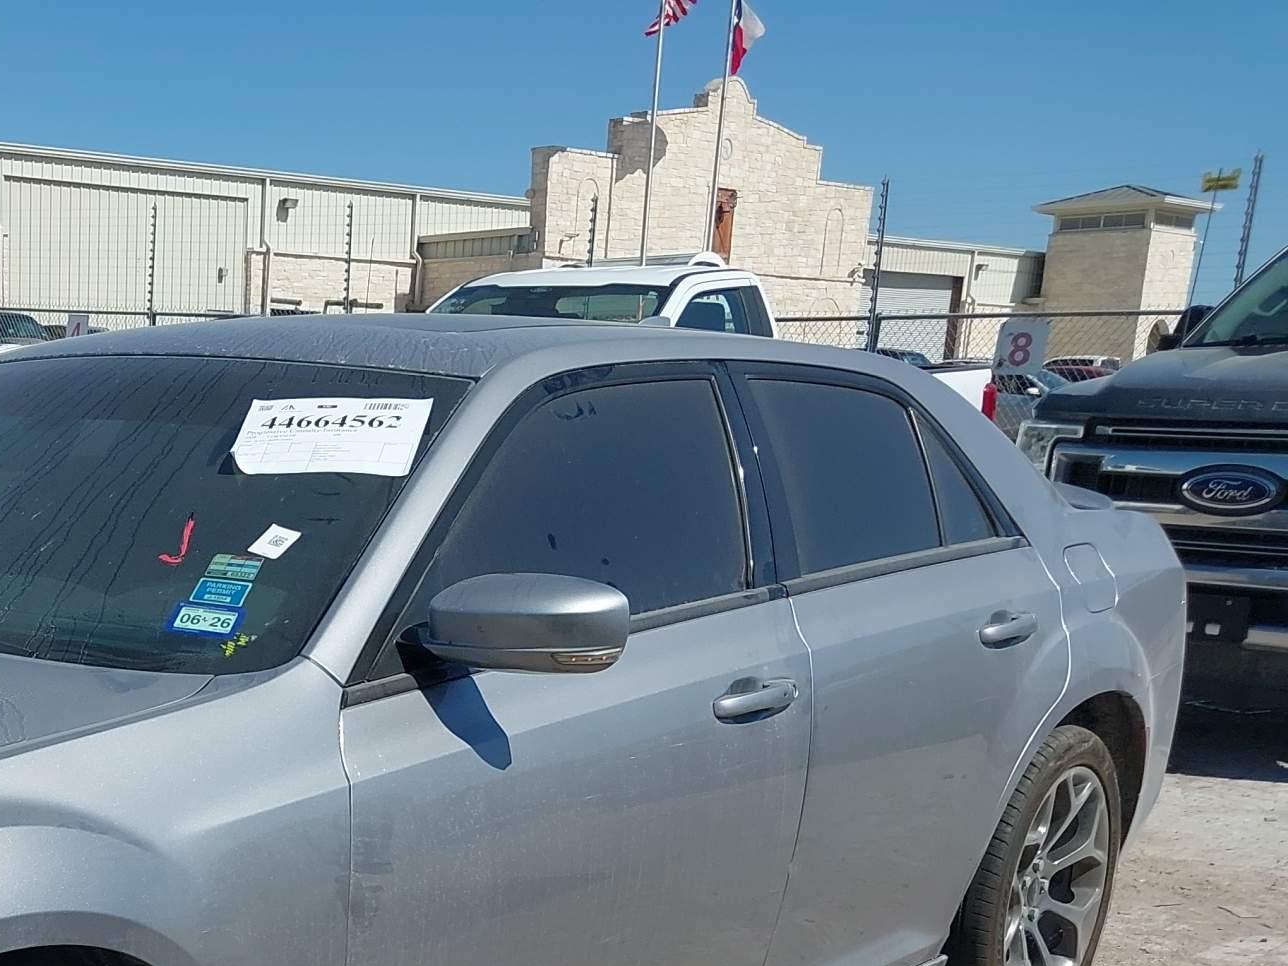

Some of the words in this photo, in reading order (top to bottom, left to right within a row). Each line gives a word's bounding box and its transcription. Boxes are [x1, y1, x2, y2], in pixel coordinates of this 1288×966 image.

[1008, 332, 1032, 367] 8
[1137, 399, 1263, 411] SUPER
[260, 415, 402, 429] 44664562
[1202, 479, 1254, 500] Ford
[206, 581, 242, 591] PARKING
[180, 613, 201, 625] 06
[209, 616, 232, 629] 26
